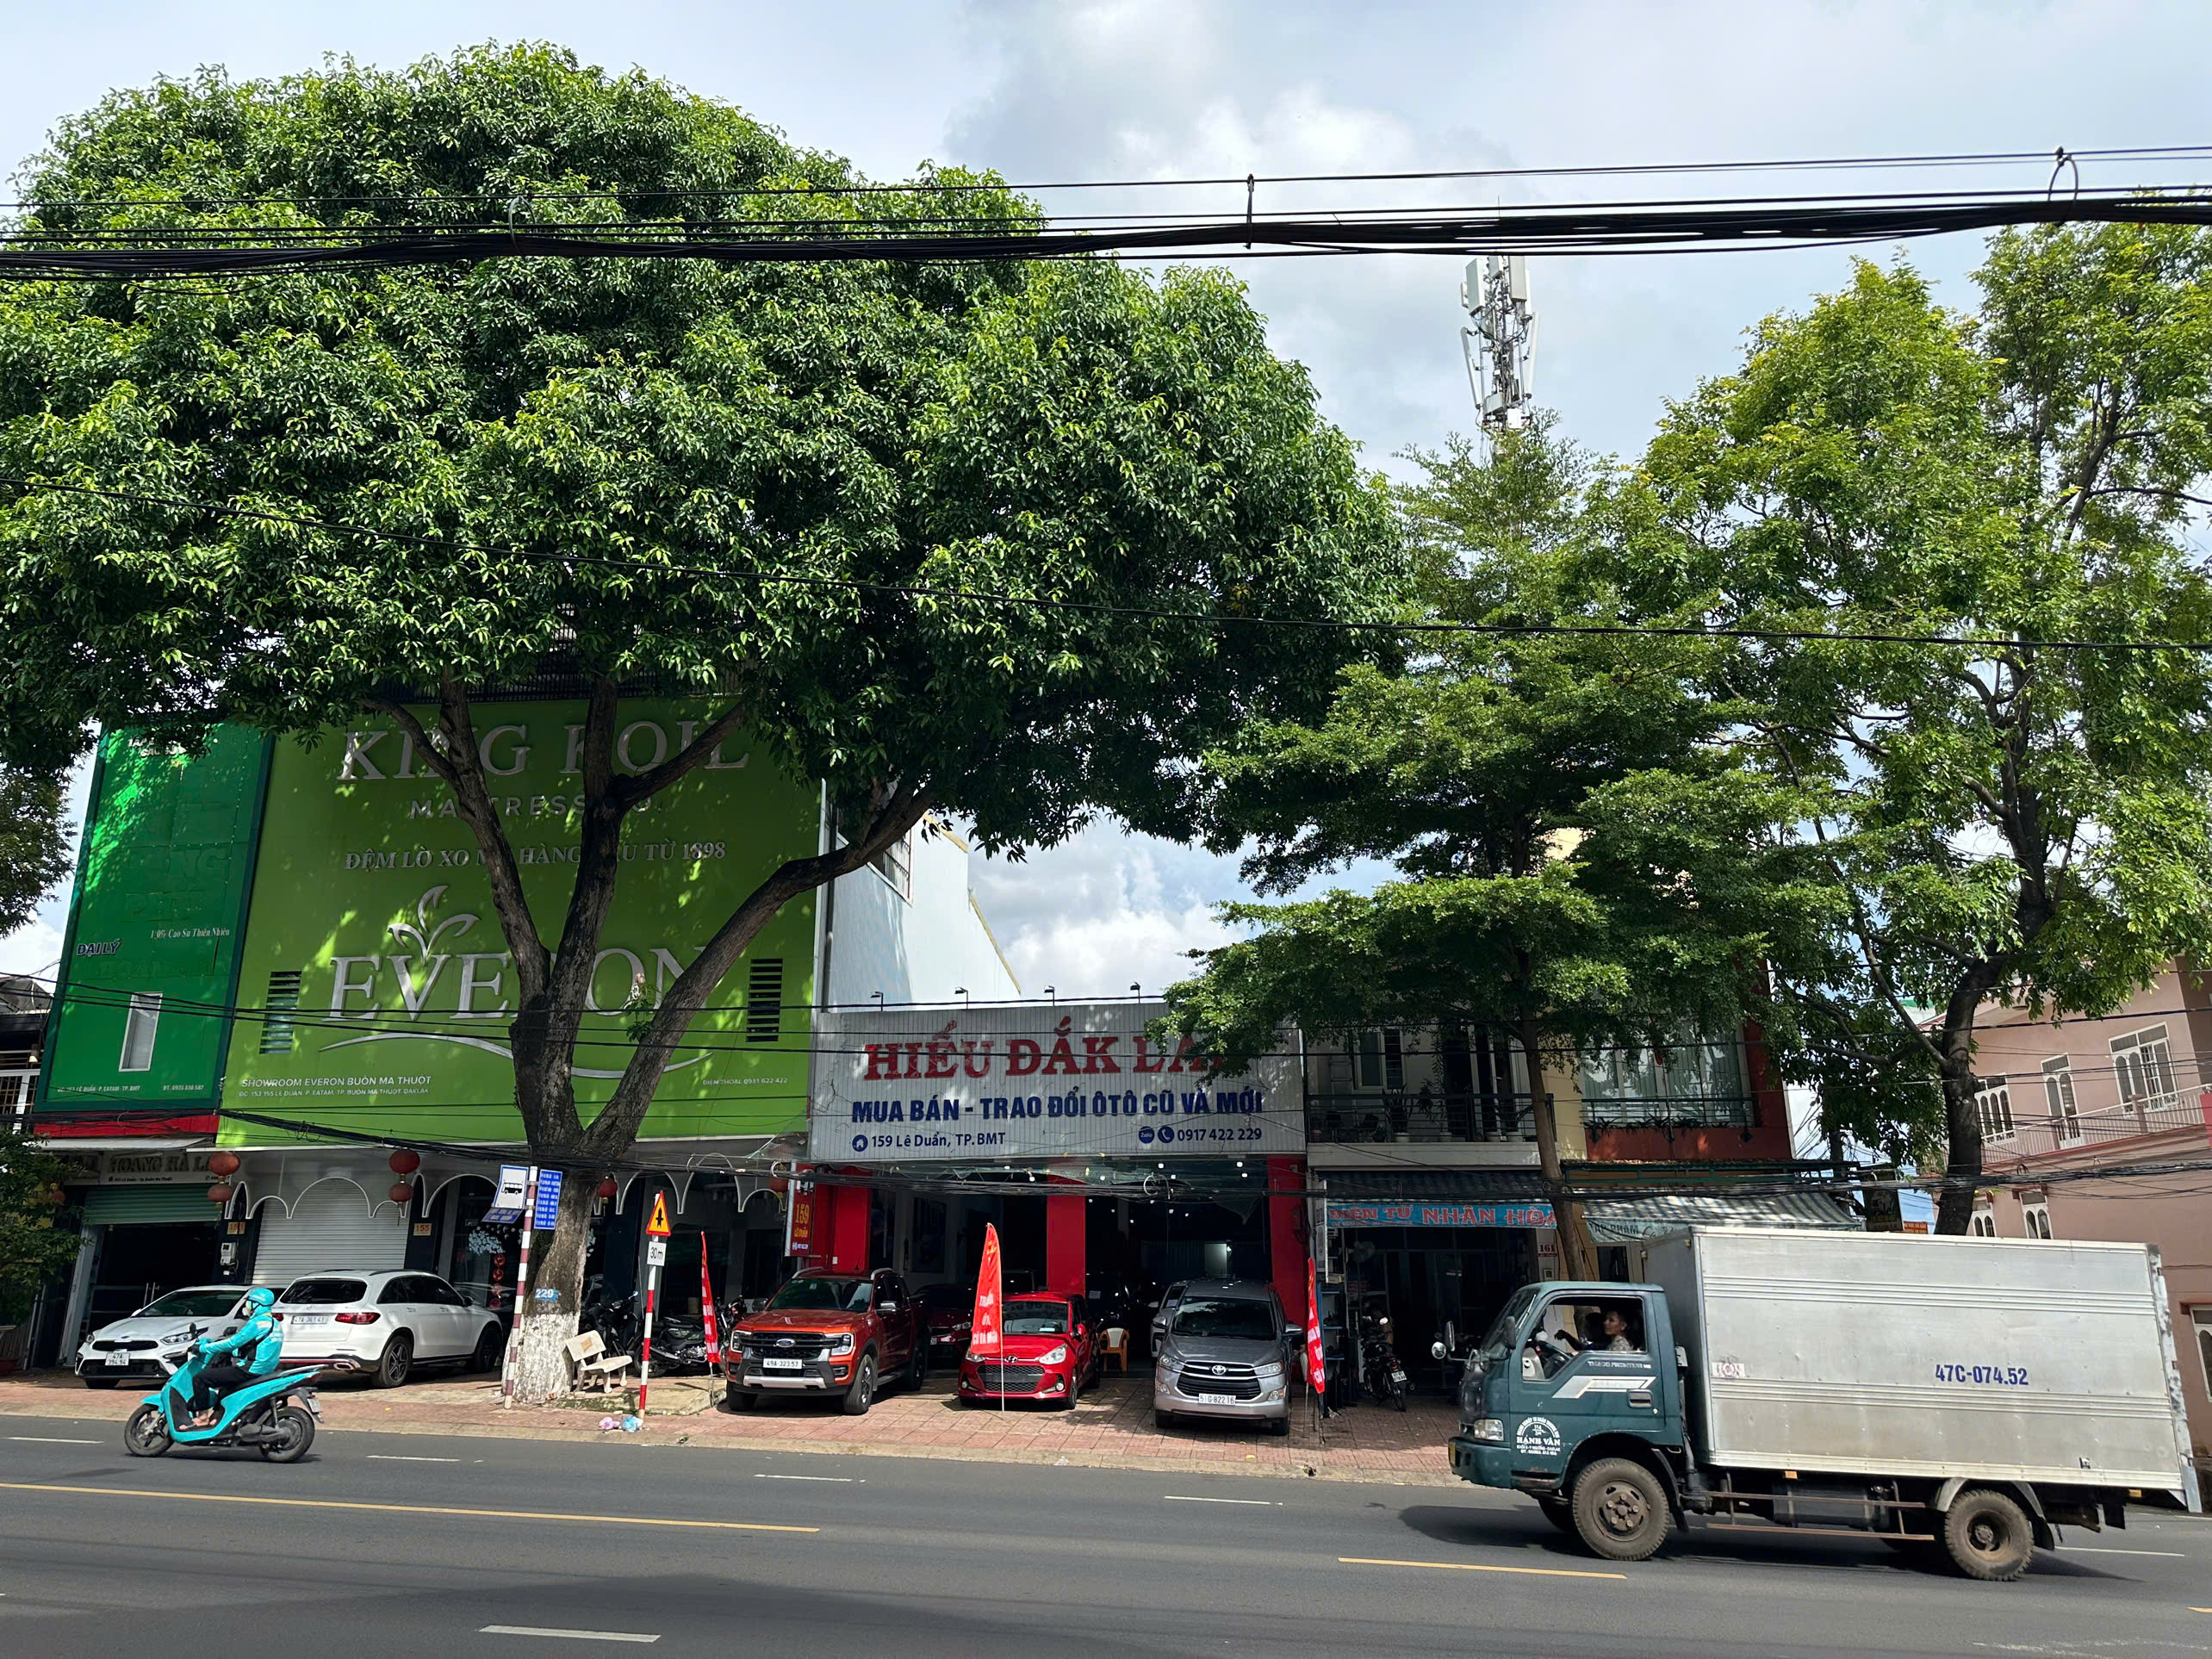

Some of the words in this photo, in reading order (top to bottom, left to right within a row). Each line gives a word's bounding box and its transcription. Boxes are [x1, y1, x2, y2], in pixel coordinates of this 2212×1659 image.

[345, 849, 399, 871] ĐỆM
[401, 846, 432, 868] LÒ
[439, 848, 469, 867] XO
[519, 841, 582, 864] HÀNG
[643, 838, 676, 861] TỪ
[682, 842, 726, 860] 1898
[321, 946, 711, 1022] EVEON
[864, 1019, 995, 1080] HIẾU
[1005, 1015, 1122, 1077] ĐẮK
[241, 1078, 302, 1088] SHOWROOM
[304, 1078, 345, 1087] EVERON
[346, 1075, 375, 1086] BUÔN
[378, 1077, 395, 1085] MA
[851, 1100, 904, 1123] MUA
[910, 1094, 960, 1122] BÁN
[979, 1096, 1042, 1120] TRAO
[1047, 1085, 1086, 1118] ĐỔI
[1091, 1090, 1138, 1116] ÔTÔ
[1143, 1089, 1175, 1115] CŨ
[1181, 1087, 1210, 1115] VÀ
[1215, 1085, 1263, 1114] MỚI
[871, 1134, 893, 1148] 159
[896, 1134, 911, 1147] Lê
[914, 1130, 952, 1148] Duẩn,
[1177, 1128, 1207, 1141] 0917
[1209, 1128, 1234, 1141] 422
[1237, 1127, 1263, 1140] 229
[795, 1203, 810, 1224] 159
[1422, 1204, 1496, 1225] NHÂN
[415, 1224, 430, 1233] 155
[1539, 1244, 1556, 1252] 161
[1935, 1364, 2029, 1386] 47C-074.52
